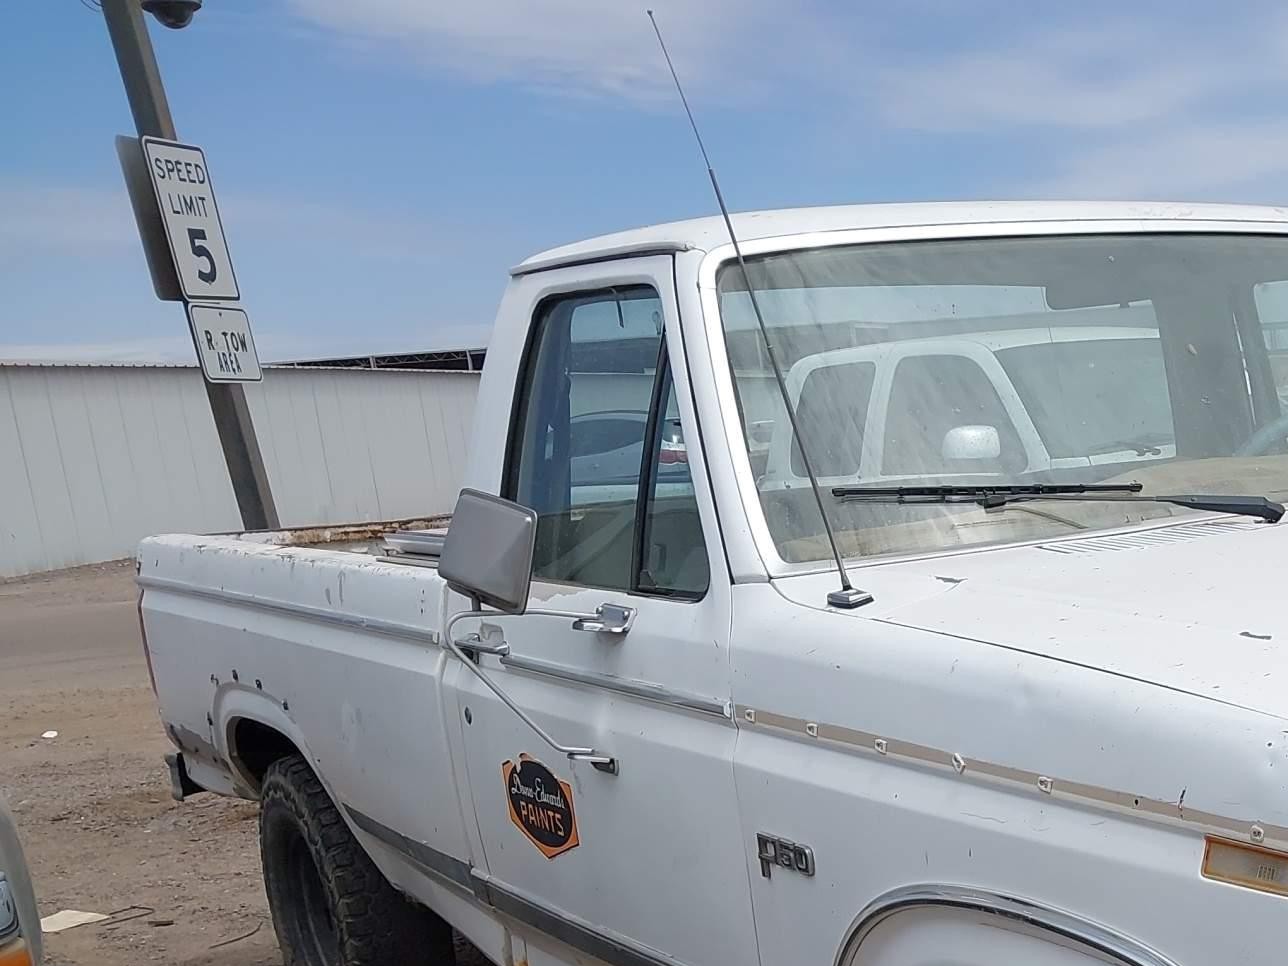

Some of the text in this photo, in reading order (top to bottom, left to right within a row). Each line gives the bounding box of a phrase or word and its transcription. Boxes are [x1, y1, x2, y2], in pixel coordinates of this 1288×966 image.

[154, 157, 206, 185] SPEED
[168, 192, 208, 218] LIMIT
[187, 228, 217, 284] 5
[222, 331, 249, 354] TOW
[216, 350, 243, 375] AREA
[519, 801, 565, 837] PAINTS
